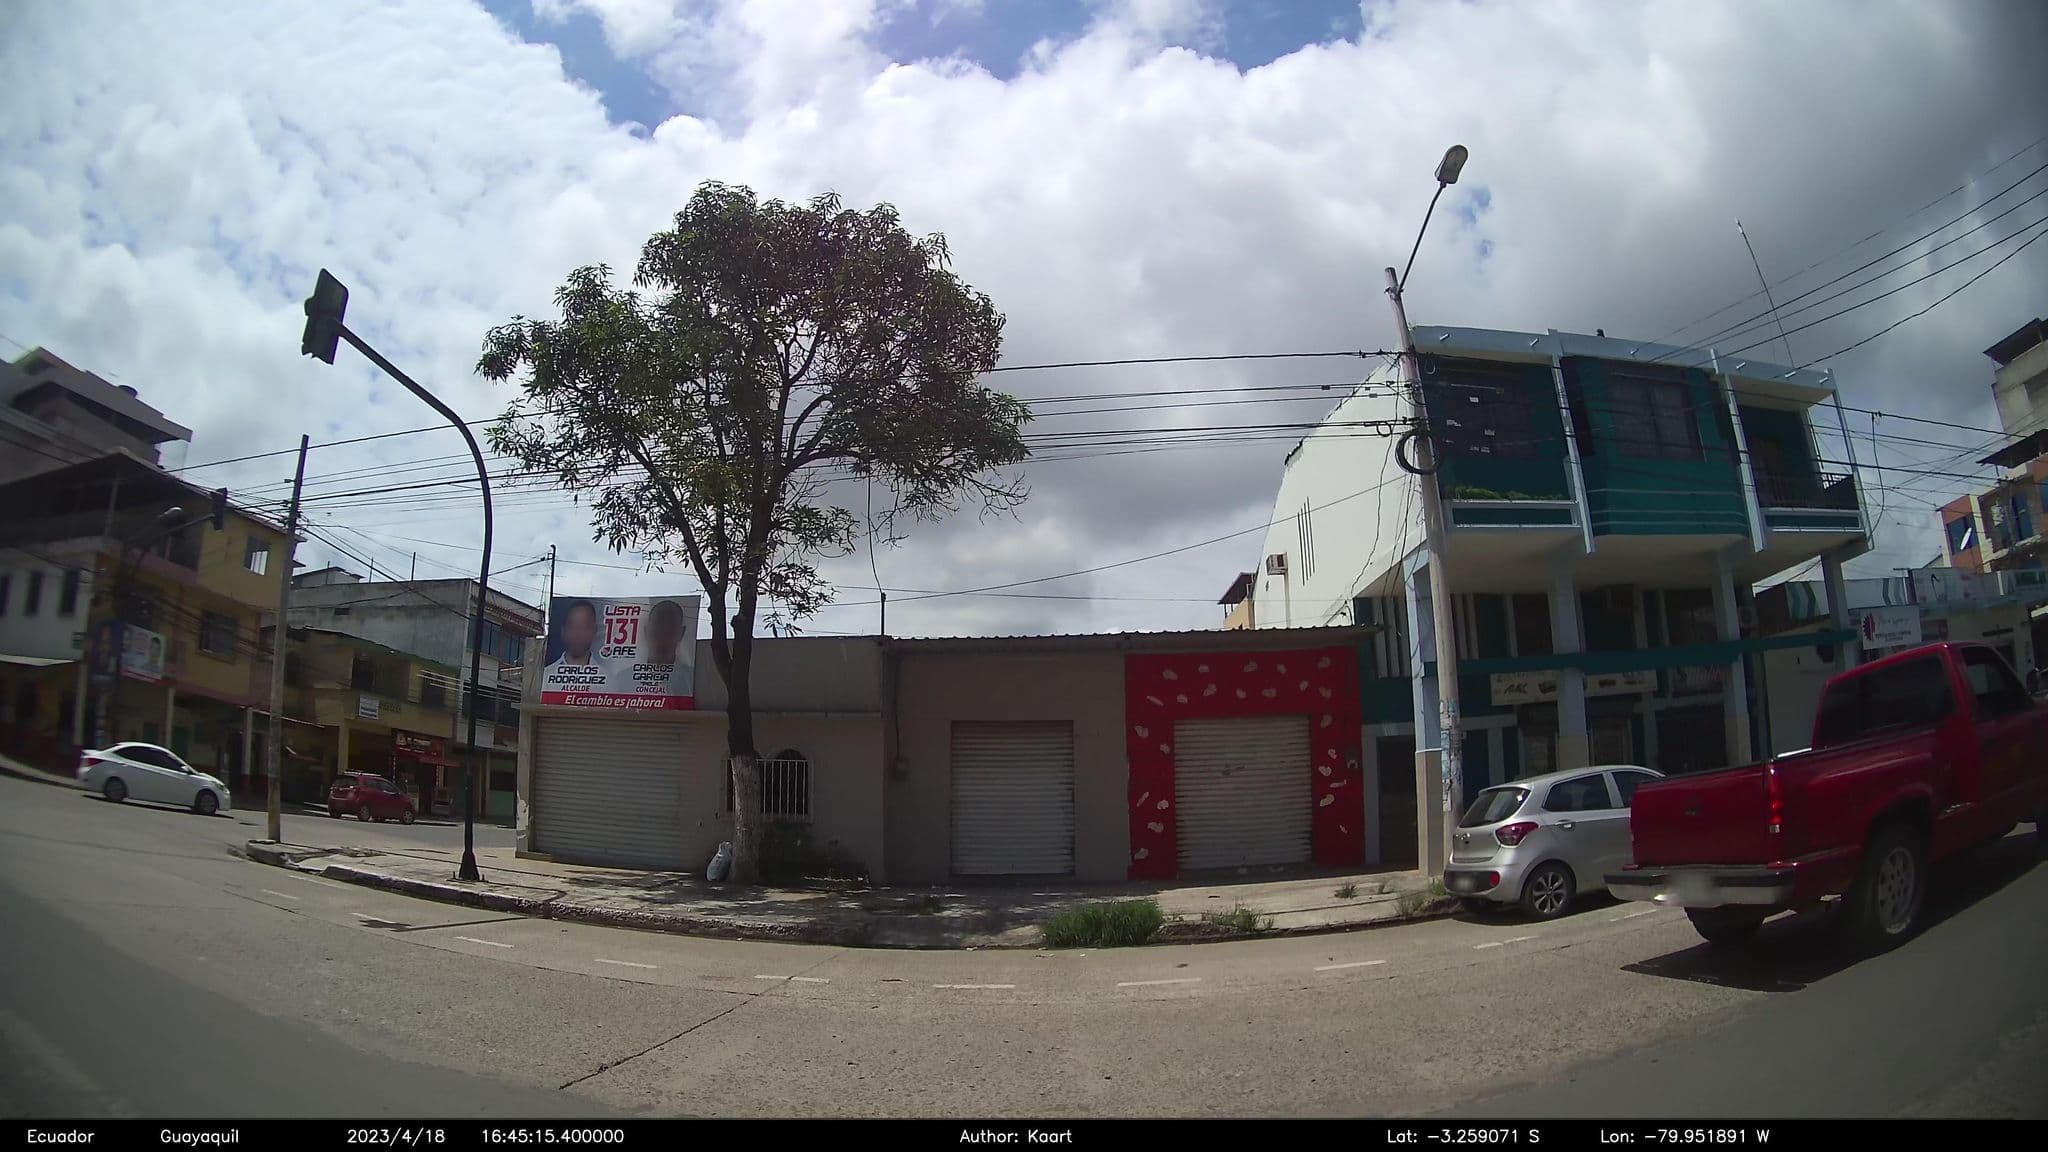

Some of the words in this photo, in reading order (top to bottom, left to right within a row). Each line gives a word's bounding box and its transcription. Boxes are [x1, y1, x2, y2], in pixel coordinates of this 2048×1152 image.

[605, 618, 639, 645] 131
[612, 646, 637, 656] AFE
[557, 666, 599, 675] CARLOS
[633, 663, 675, 672] CARLOS
[636, 686, 666, 694] CONCEJAL
[565, 695, 575, 704] El
[577, 695, 612, 706] cambio
[614, 698, 626, 706] es
